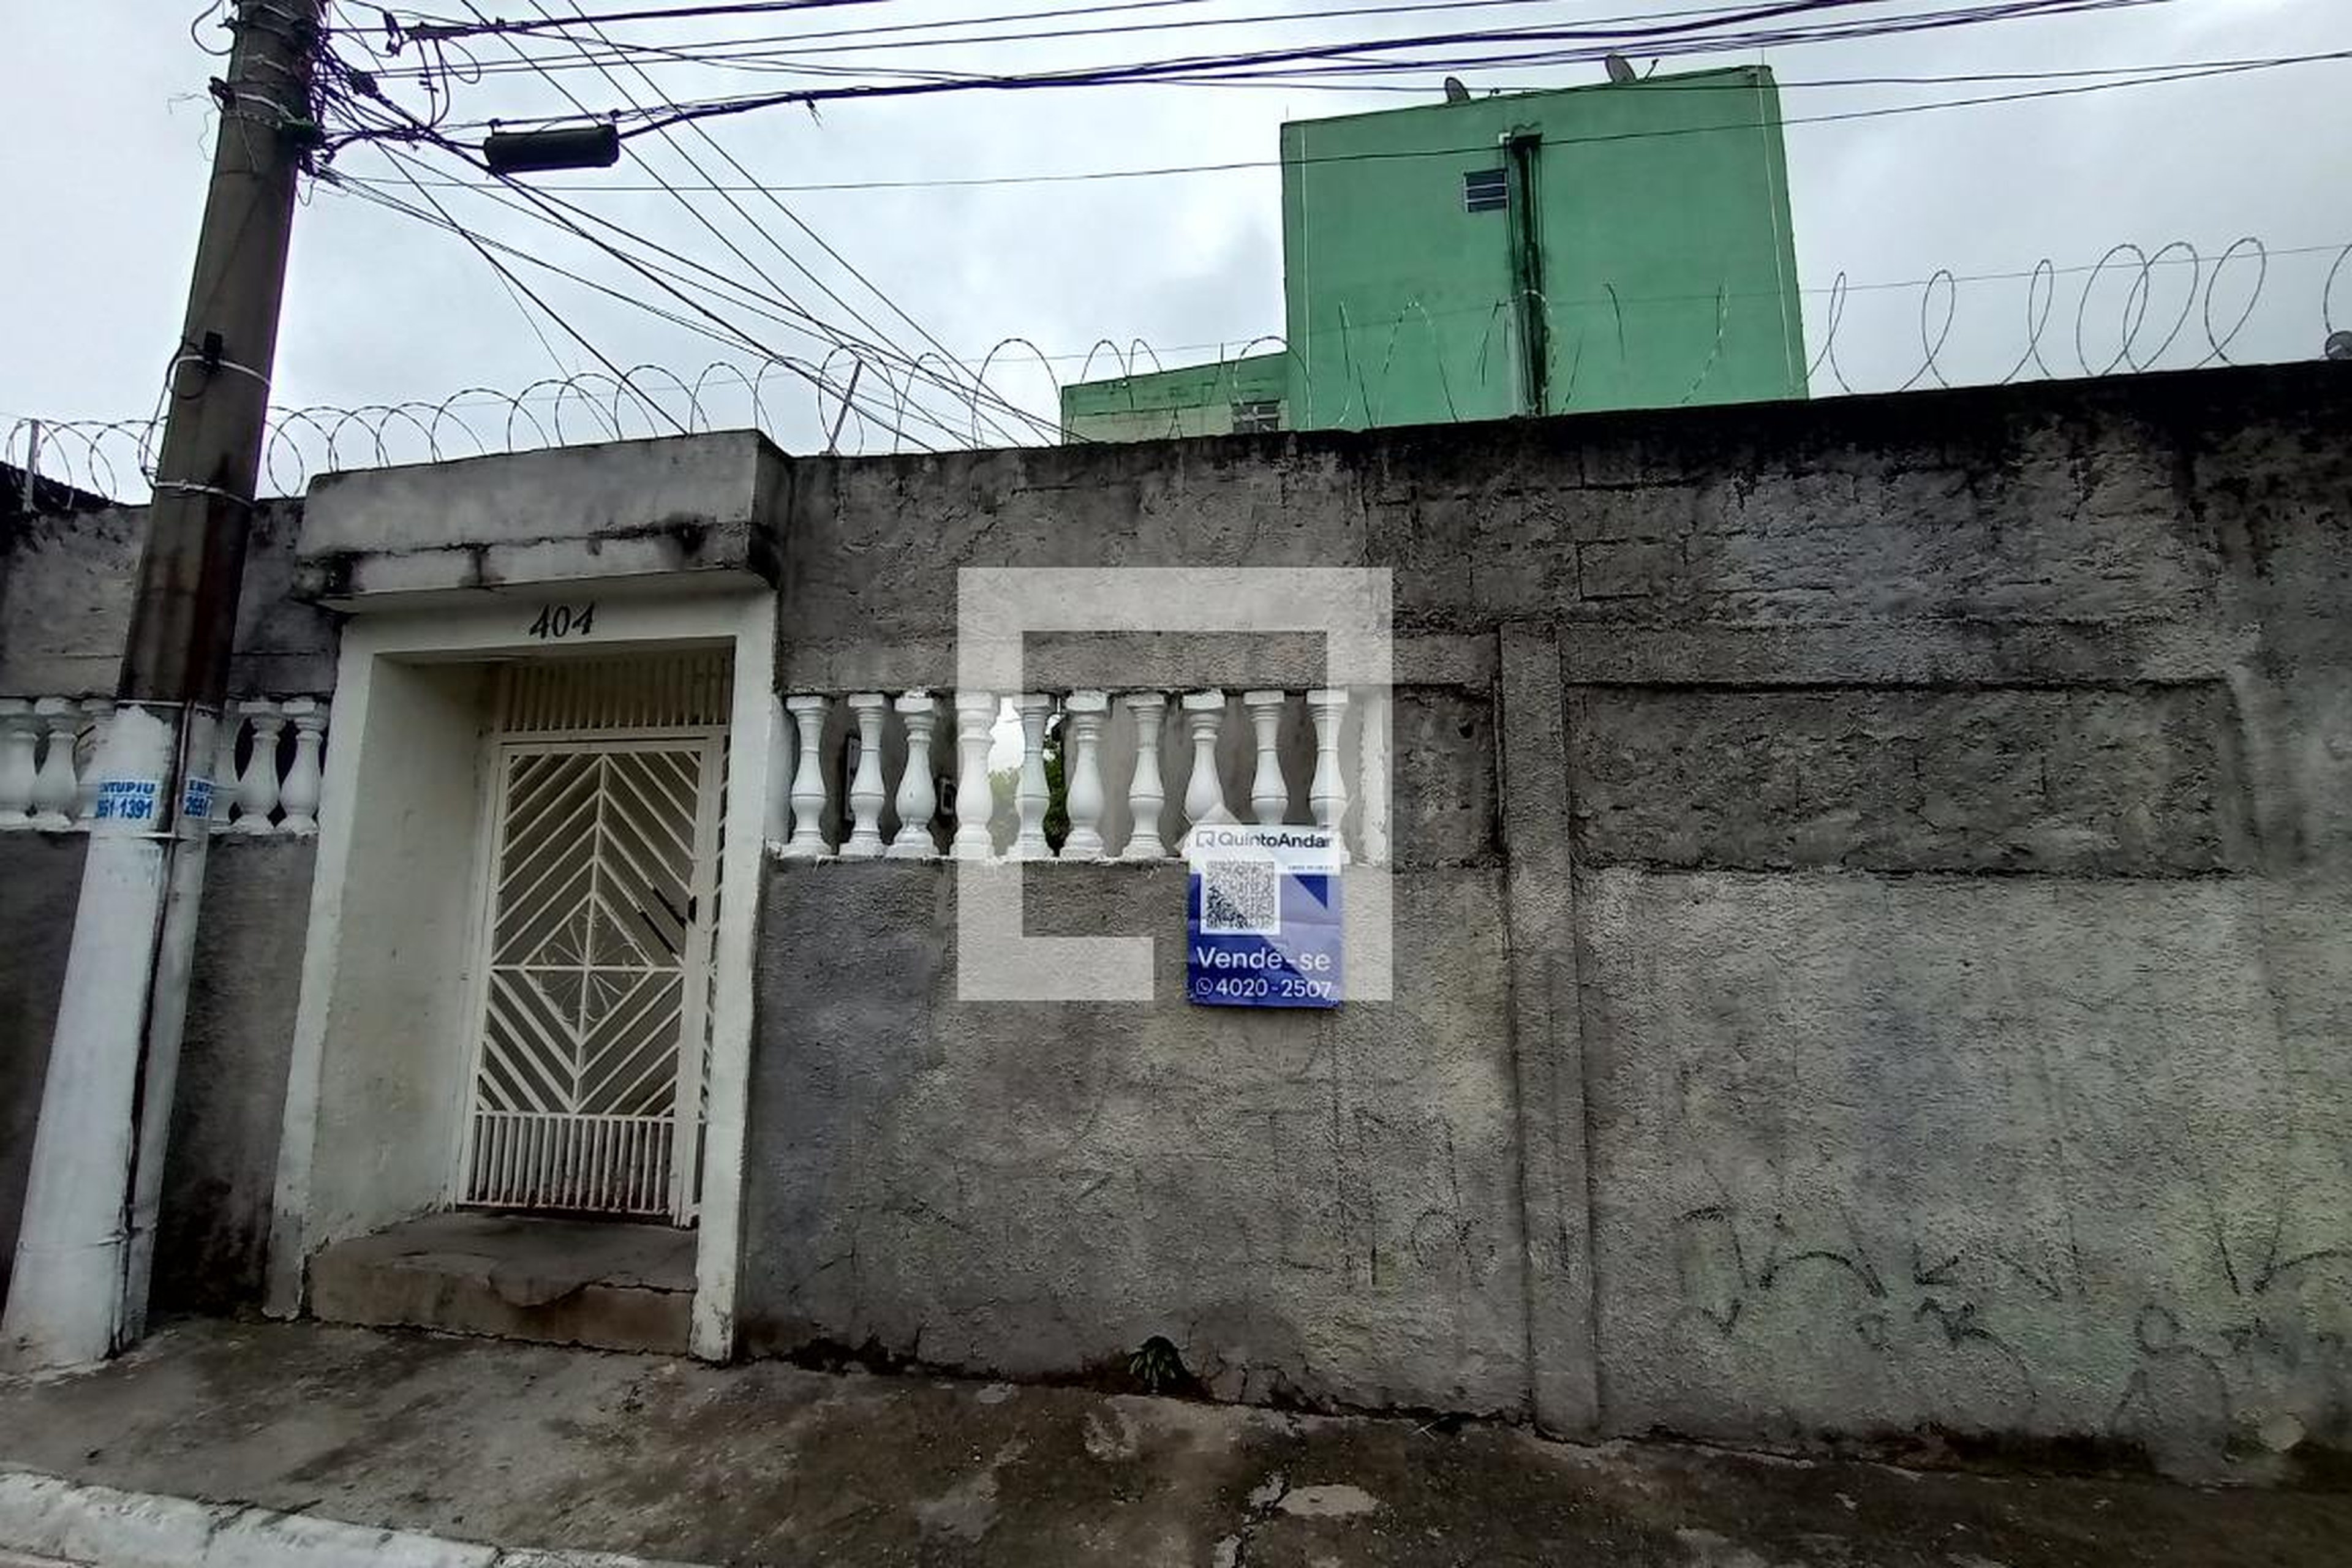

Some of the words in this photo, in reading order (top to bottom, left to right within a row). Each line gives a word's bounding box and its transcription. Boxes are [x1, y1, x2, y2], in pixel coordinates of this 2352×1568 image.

[529, 601, 595, 639] 404
[1218, 832, 1332, 850] QuintoAndar
[1196, 947, 1331, 971] Vende-se
[1216, 978, 1332, 998] 4020-2507
